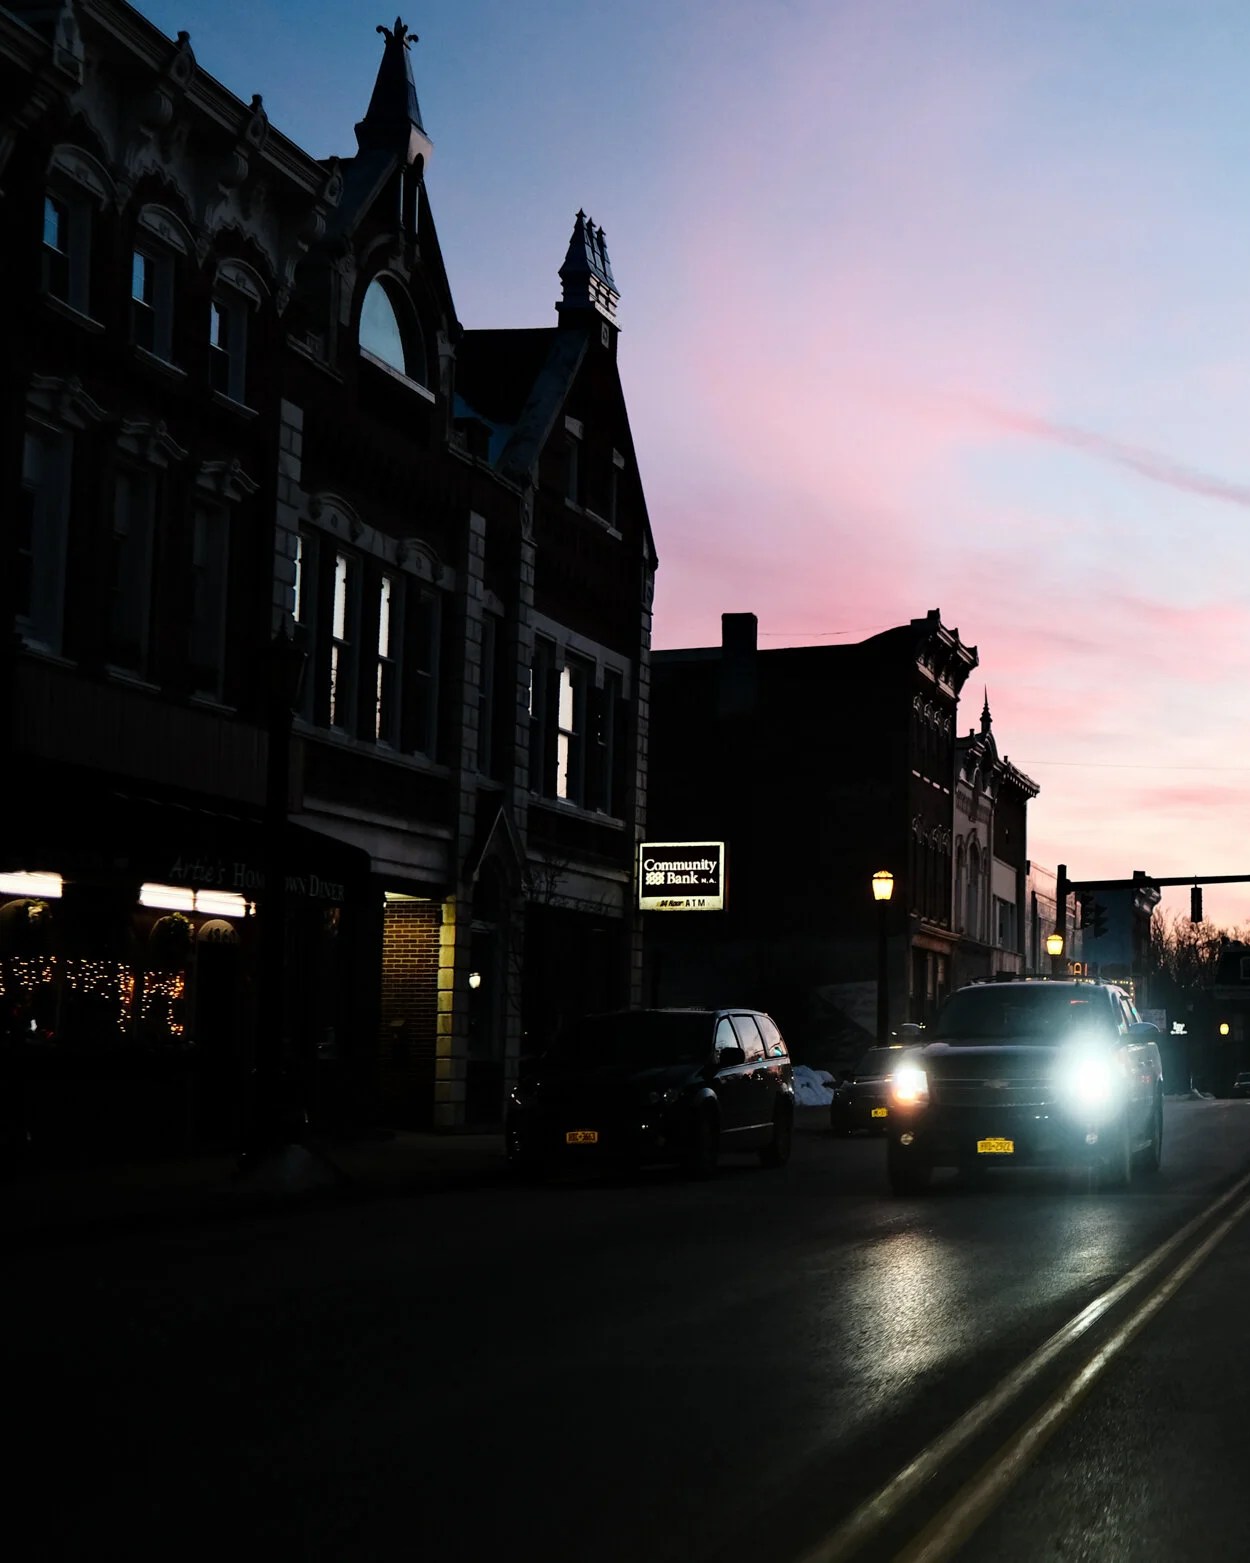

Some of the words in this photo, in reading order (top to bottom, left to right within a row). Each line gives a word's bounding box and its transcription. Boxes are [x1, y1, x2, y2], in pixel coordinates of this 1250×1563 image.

[643, 858, 718, 874] Community
[168, 853, 226, 885] Artie's
[309, 874, 345, 902] DINER
[666, 870, 699, 885] Bank
[685, 899, 706, 907] ATM
